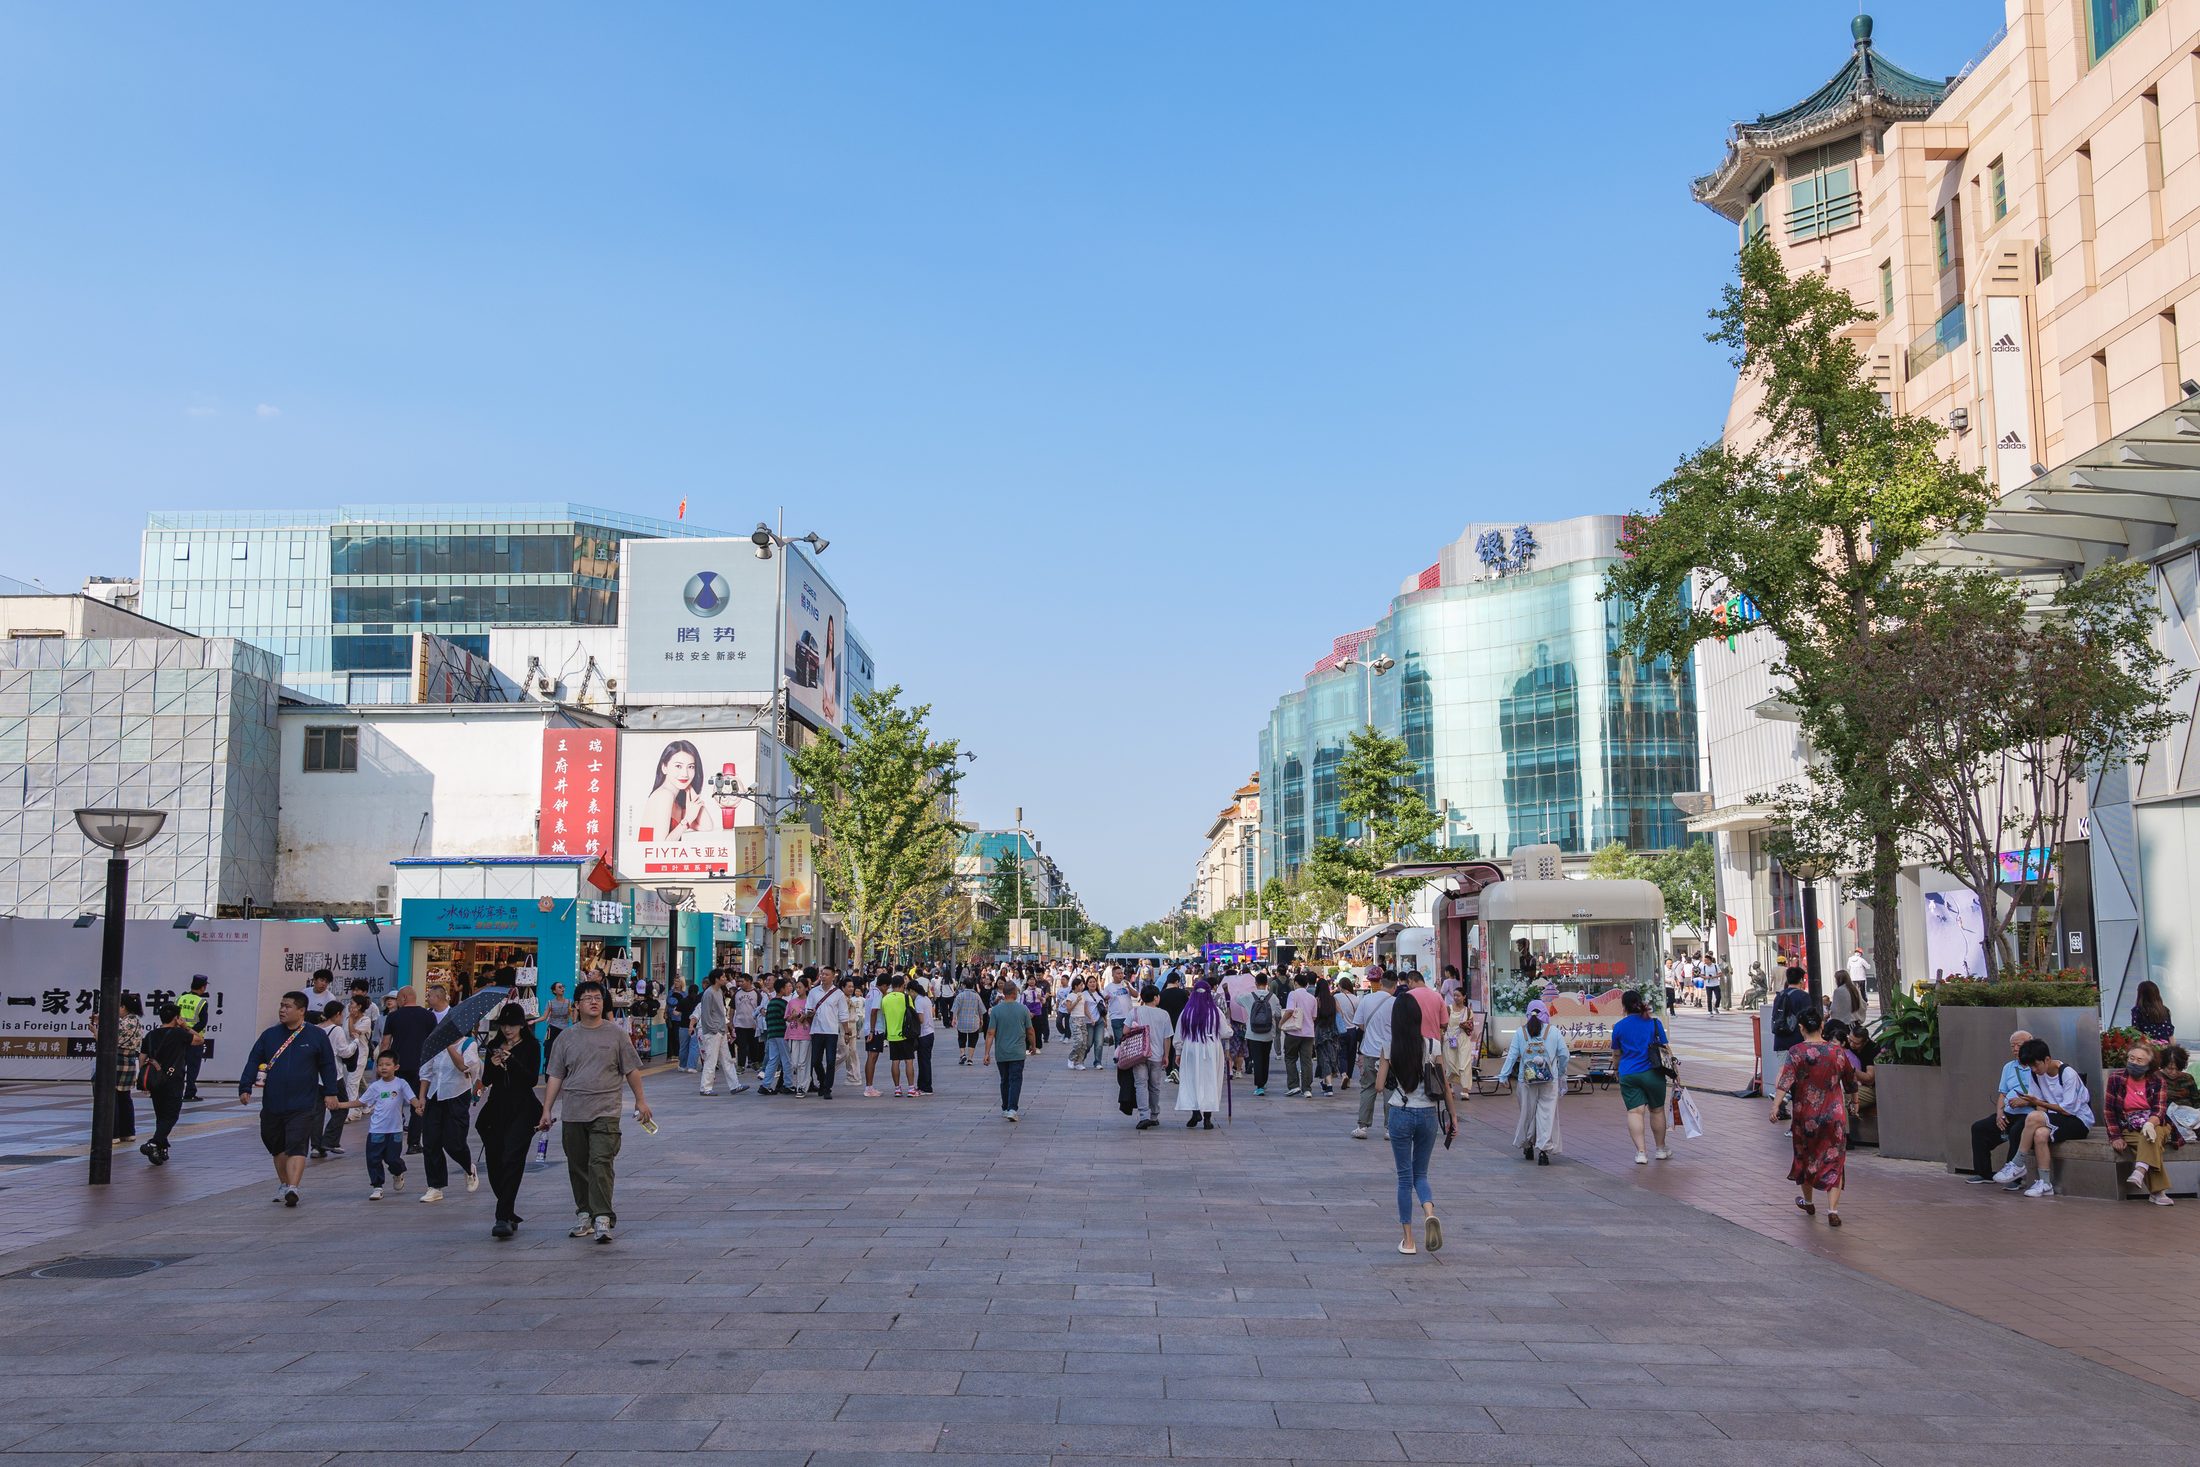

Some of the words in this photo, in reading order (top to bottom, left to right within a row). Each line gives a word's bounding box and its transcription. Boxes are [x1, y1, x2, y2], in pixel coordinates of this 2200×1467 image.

[1991, 345, 2021, 353] adidas
[1997, 442, 2027, 450] adidas
[1474, 524, 1537, 563] 银泰
[677, 626, 736, 643] 腾势
[664, 651, 685, 661] 科技
[690, 651, 710, 661] 安全
[716, 651, 747, 661] 新豪华
[551, 738, 569, 856] 王府井钟表城
[585, 738, 603, 855] 瑞士名表维修
[644, 847, 688, 858] FIYTA
[691, 847, 729, 858] 飞亚达
[660, 864, 713, 872] 四叶草系列
[2, 1021, 12, 1030] is
[23, 1020, 68, 1033] Foreign
